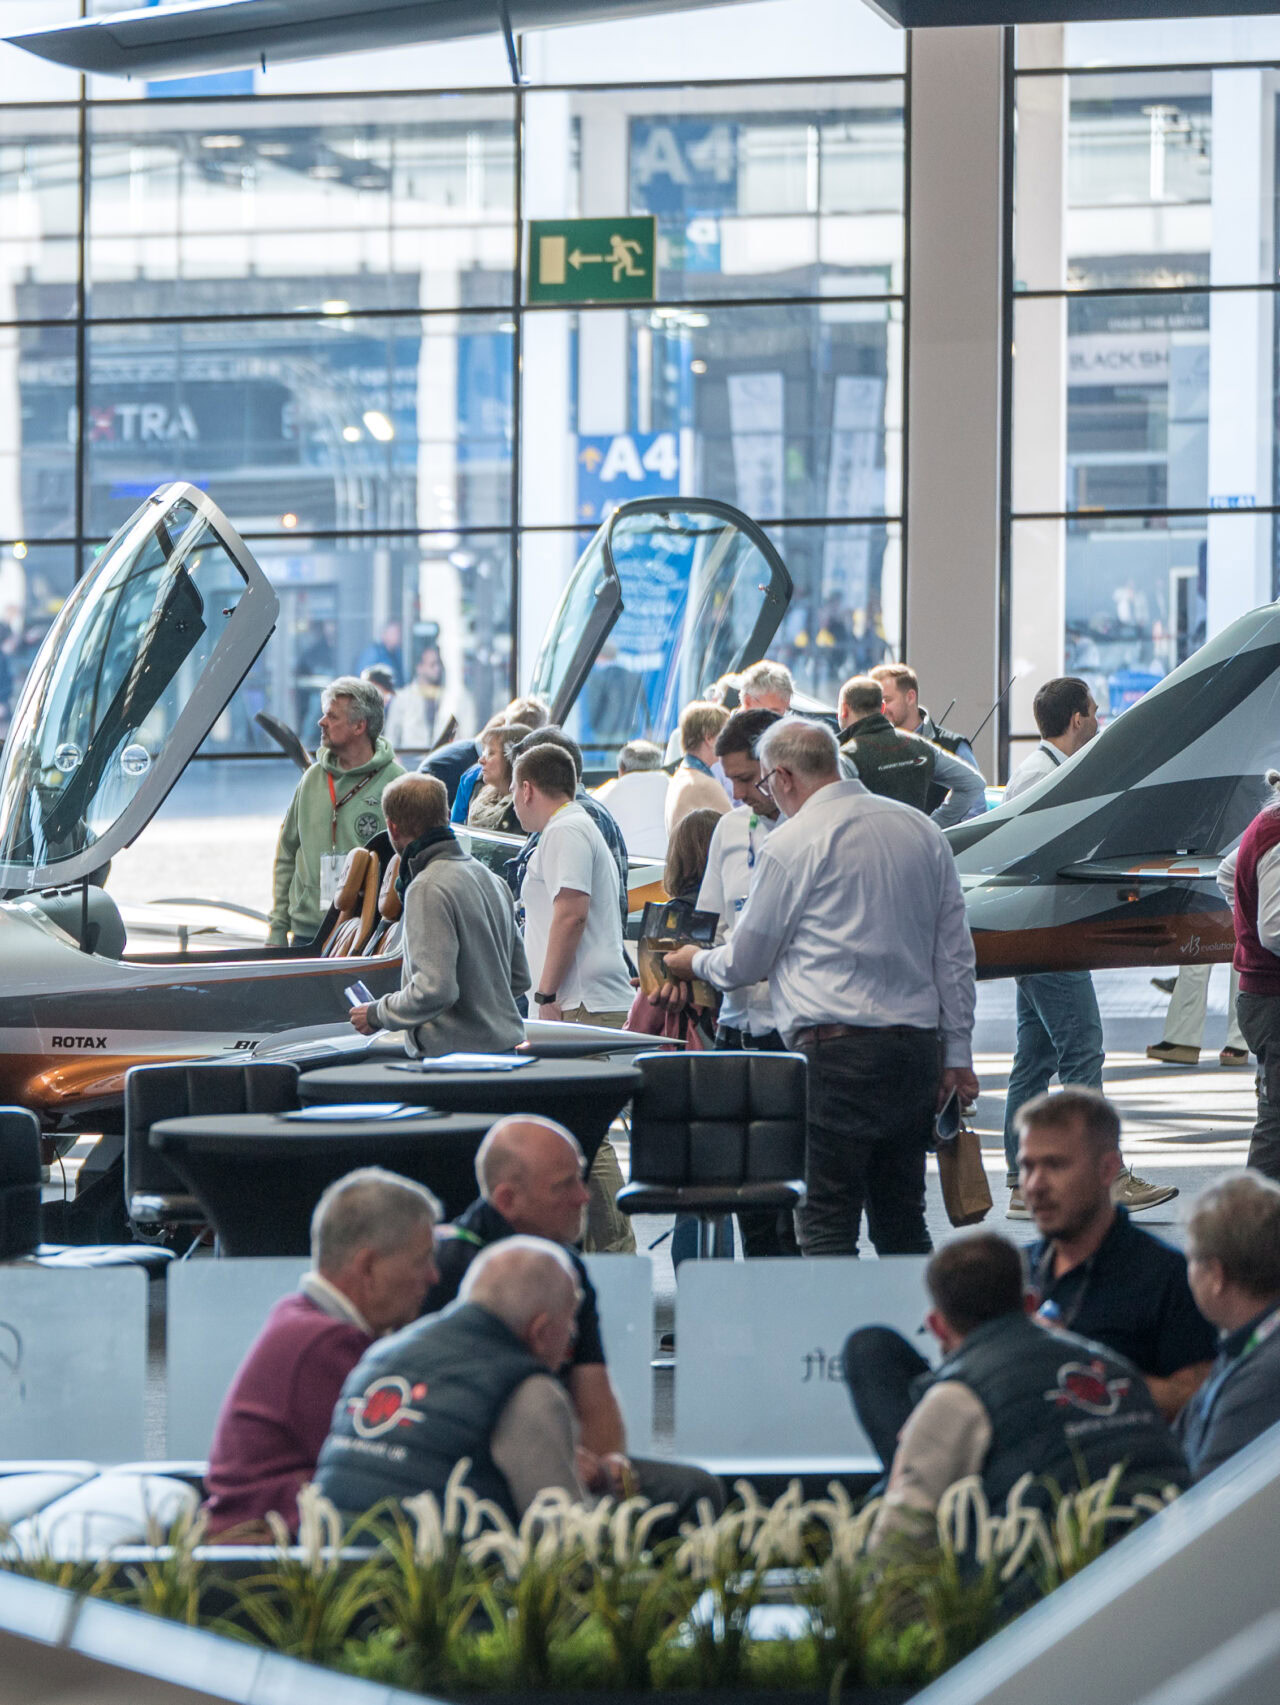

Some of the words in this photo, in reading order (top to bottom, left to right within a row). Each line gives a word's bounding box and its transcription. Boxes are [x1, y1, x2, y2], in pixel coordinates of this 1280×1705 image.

[637, 124, 732, 184] A4
[1069, 350, 1168, 371] BLACKSH
[600, 433, 678, 481] A4
[51, 1035, 108, 1049] ROTAX
